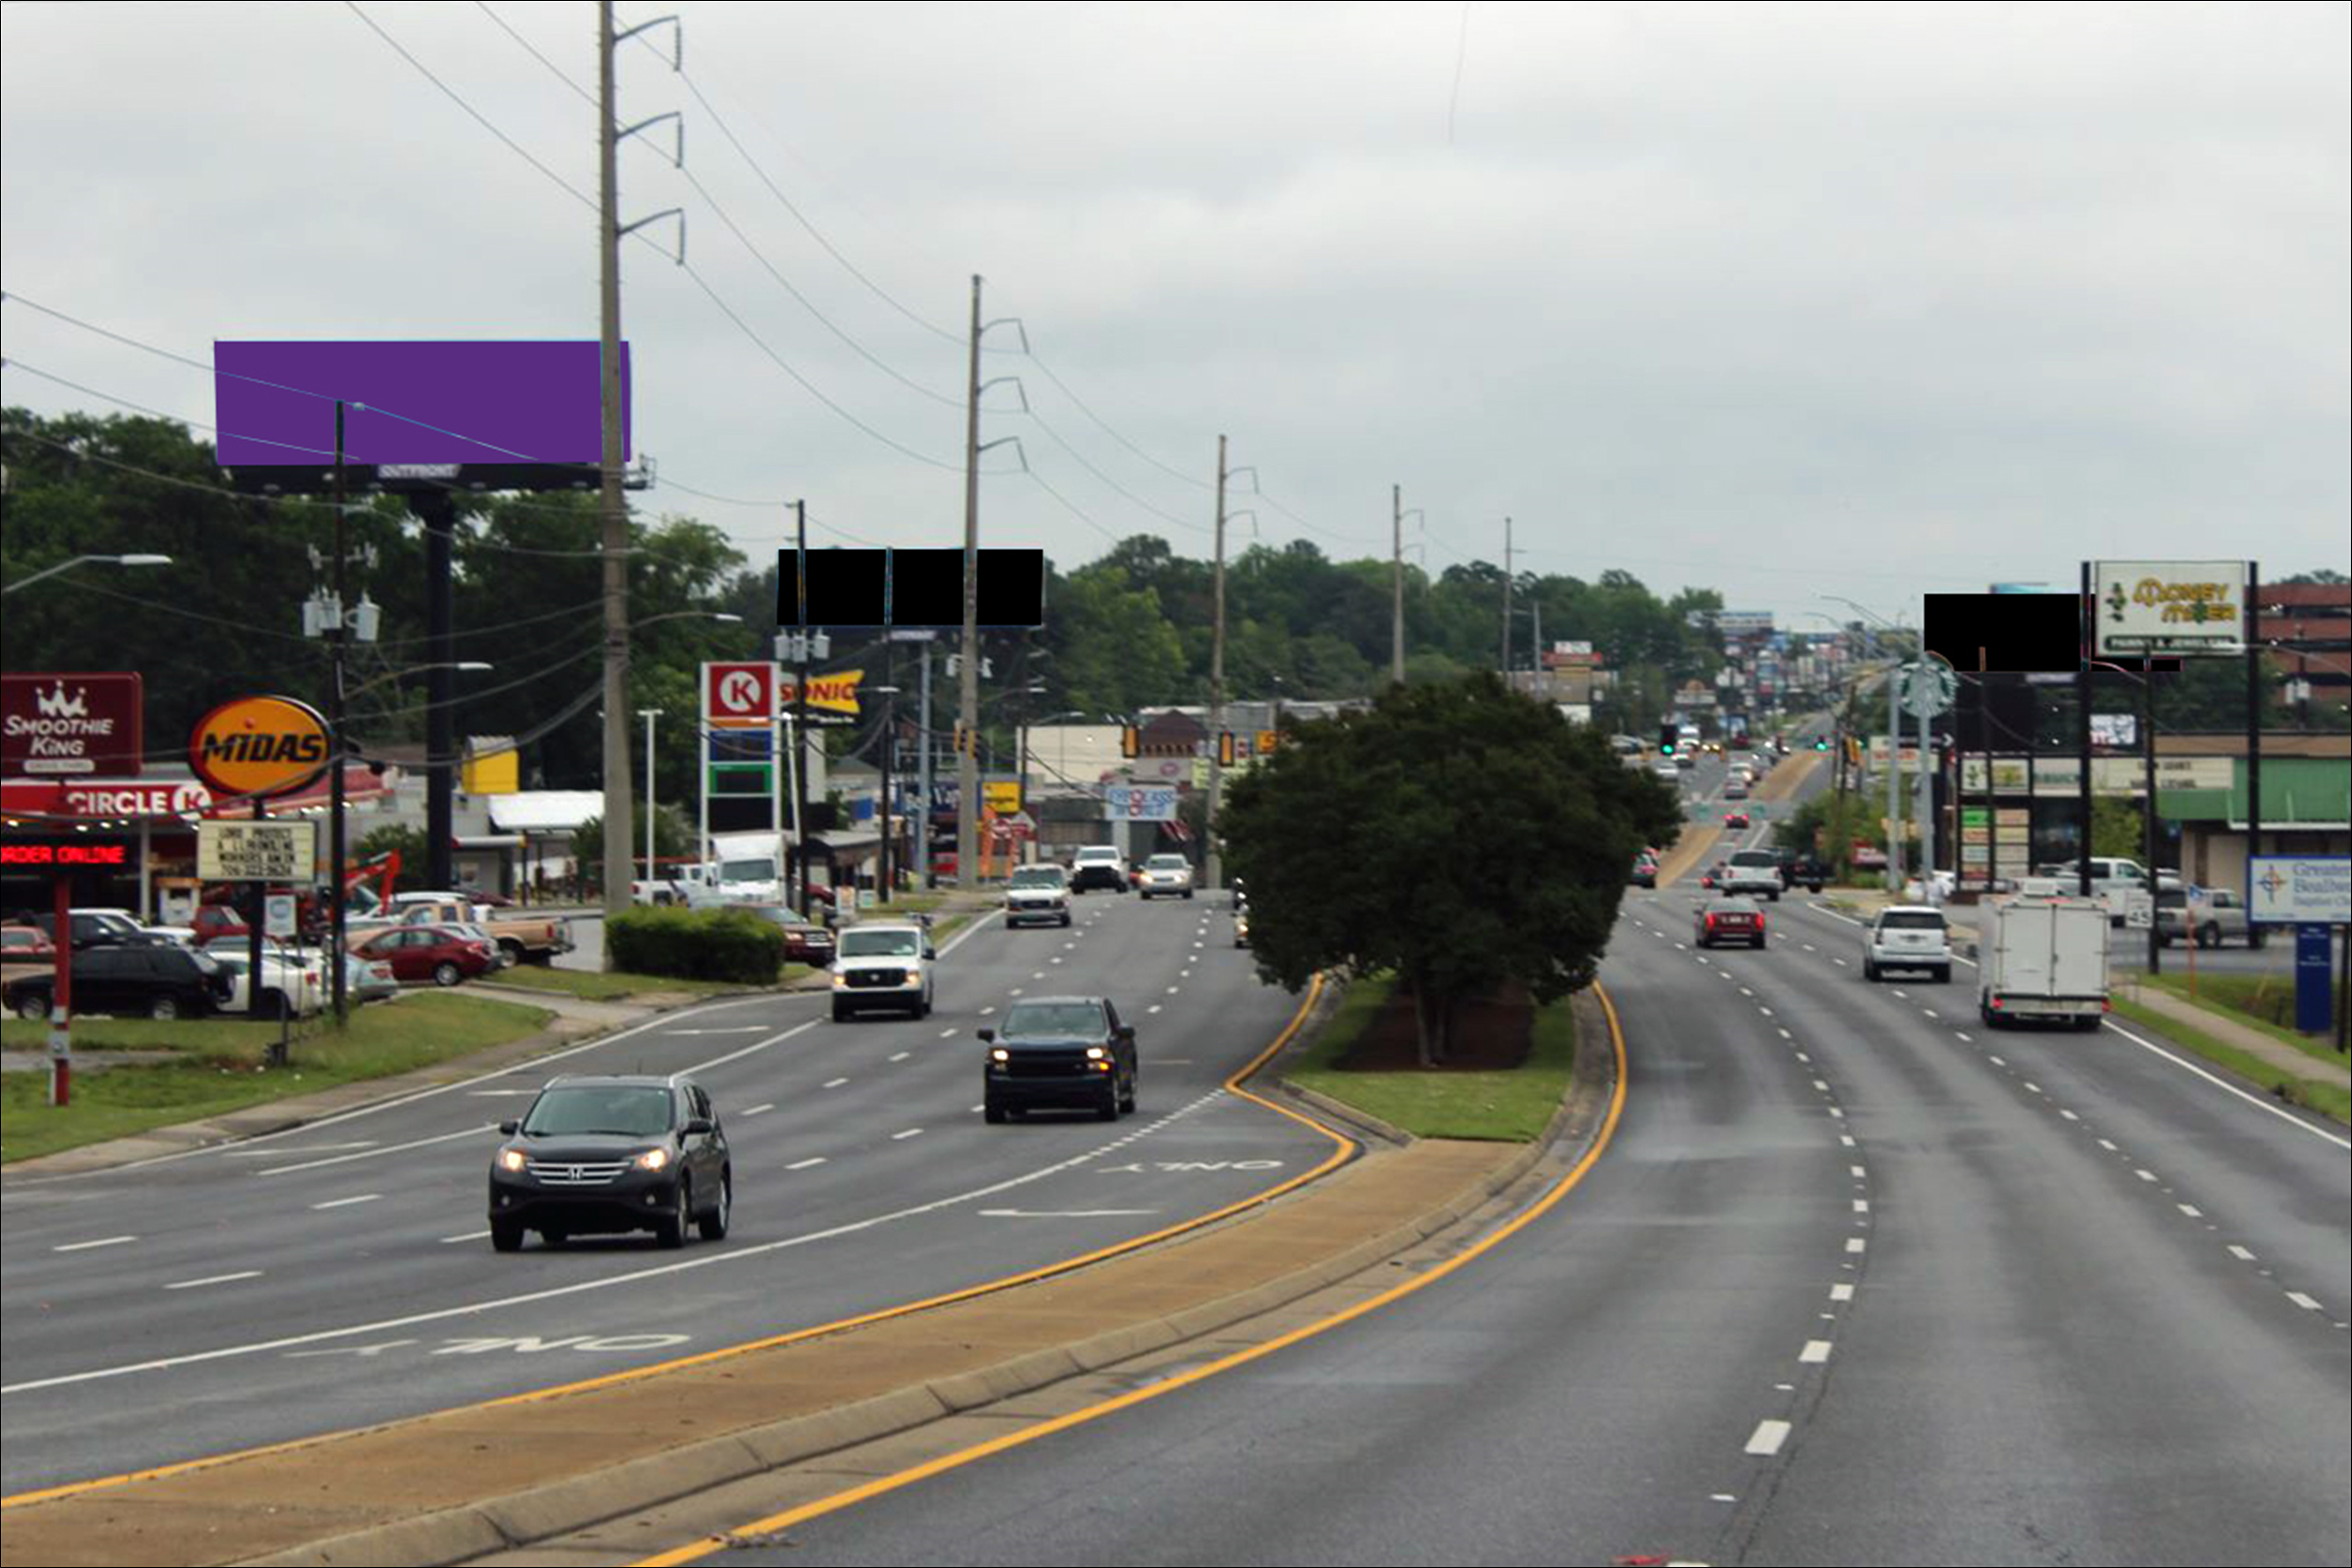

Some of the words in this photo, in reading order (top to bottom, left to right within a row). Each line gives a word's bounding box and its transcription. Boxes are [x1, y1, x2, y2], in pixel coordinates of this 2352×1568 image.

[2132, 577, 2229, 607] MONEY
[731, 679, 757, 708] K
[4, 715, 115, 735] SMOOTHIE
[201, 732, 323, 763] MIDAS
[68, 792, 168, 814] CIRCLE
[58, 846, 125, 863] ONLINE
[2128, 910, 2150, 924] 45
[1096, 1159, 1284, 1175] ONLY
[283, 1334, 692, 1357] ONLY
